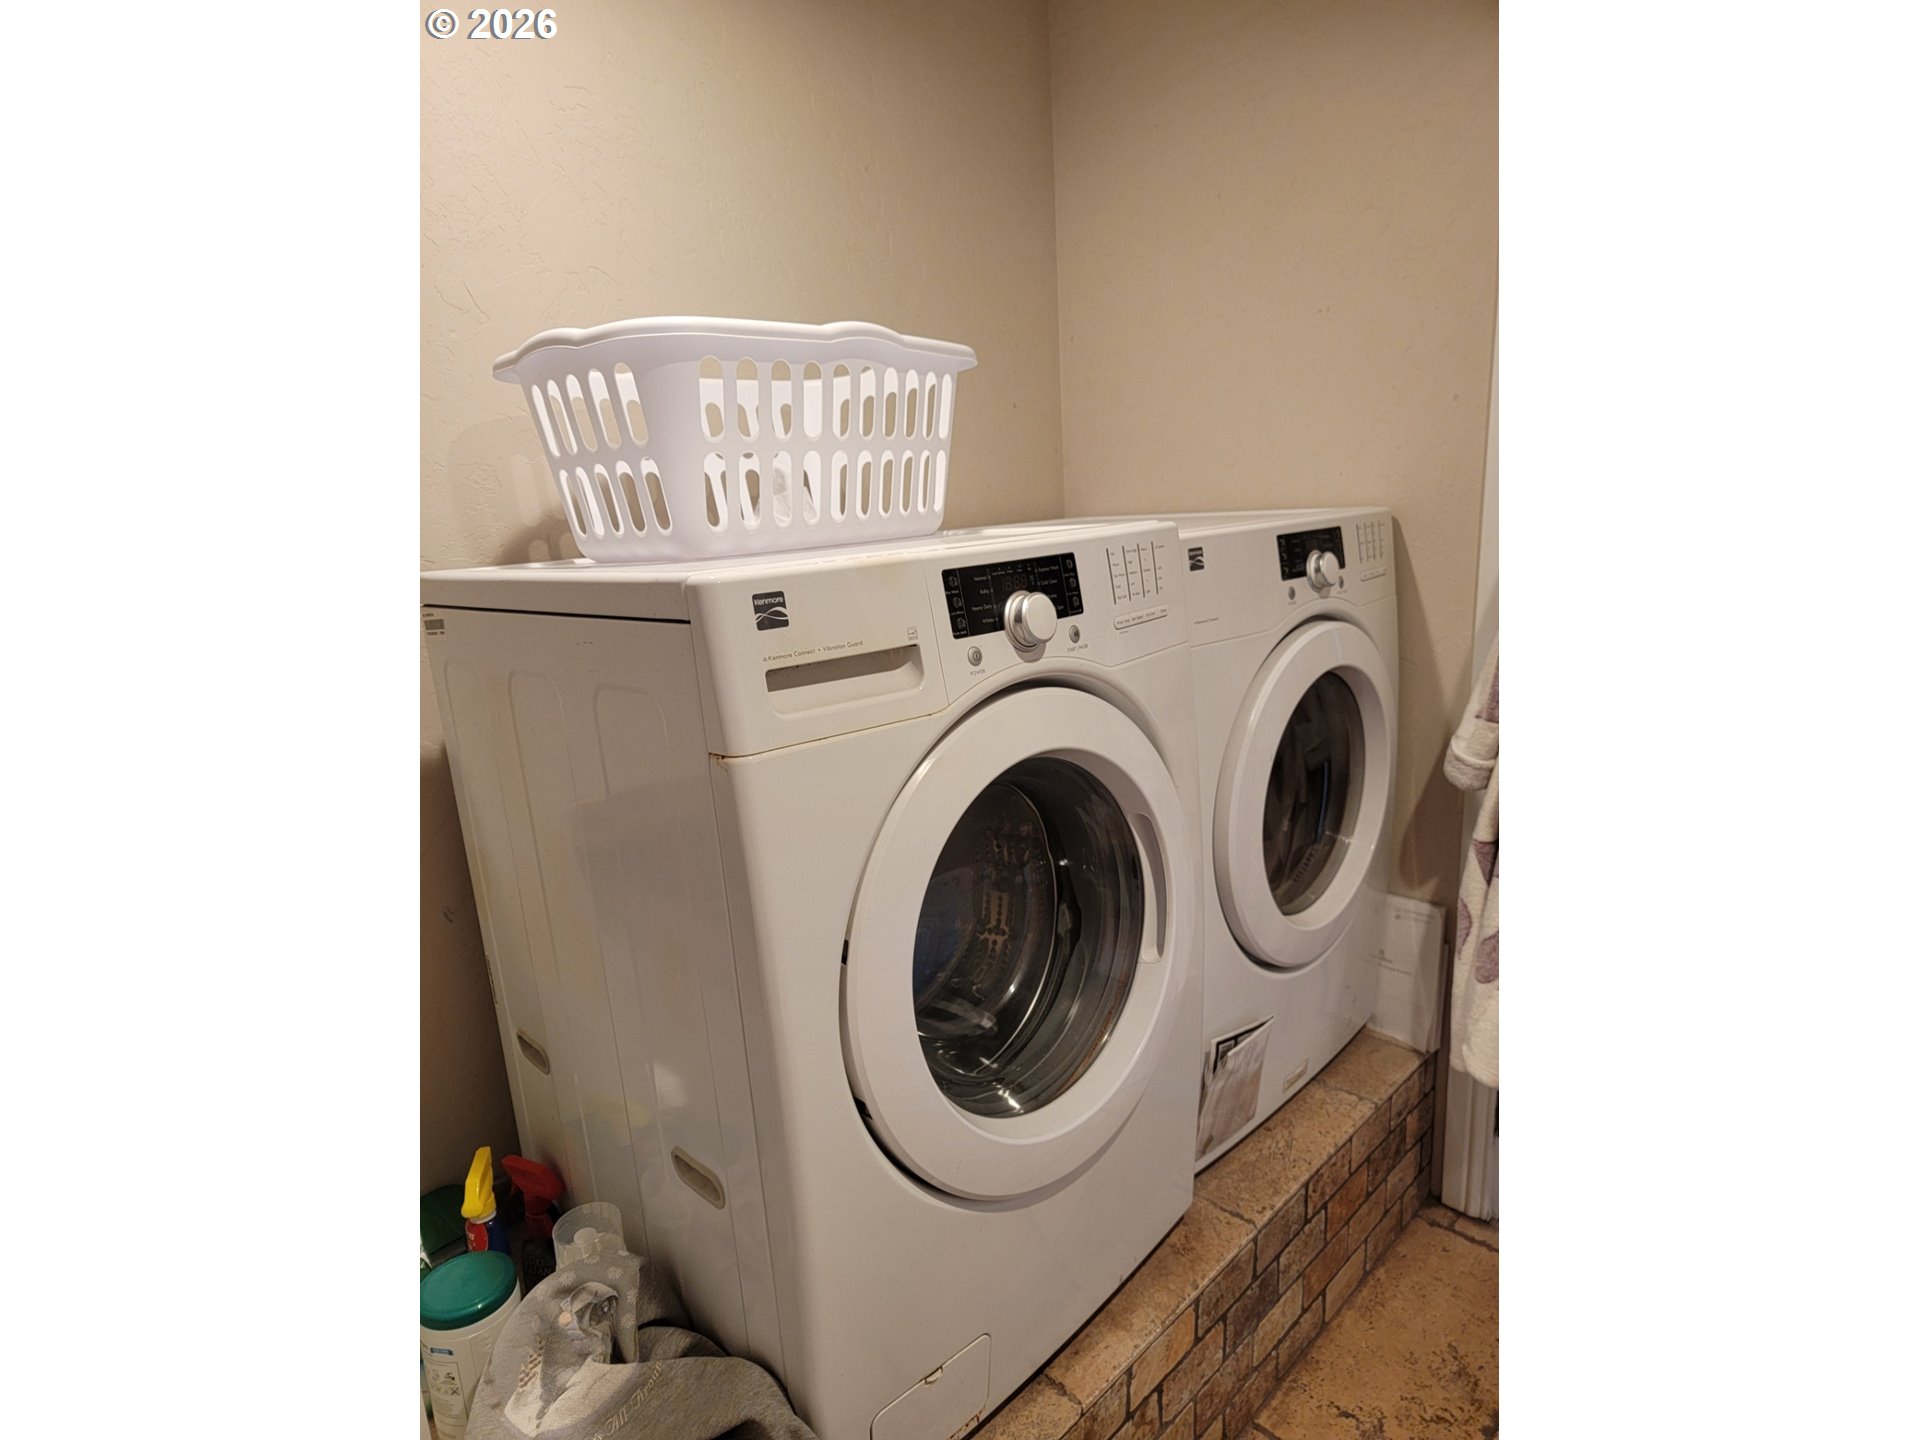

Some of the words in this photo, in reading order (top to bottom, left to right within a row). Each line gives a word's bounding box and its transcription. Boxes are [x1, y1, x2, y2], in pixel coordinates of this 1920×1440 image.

[754, 596, 784, 606] Kenmore
[768, 653, 793, 662] Kenmore
[794, 649, 816, 657] Connect
[822, 643, 846, 652] Vibration
[847, 640, 864, 648] Guard
